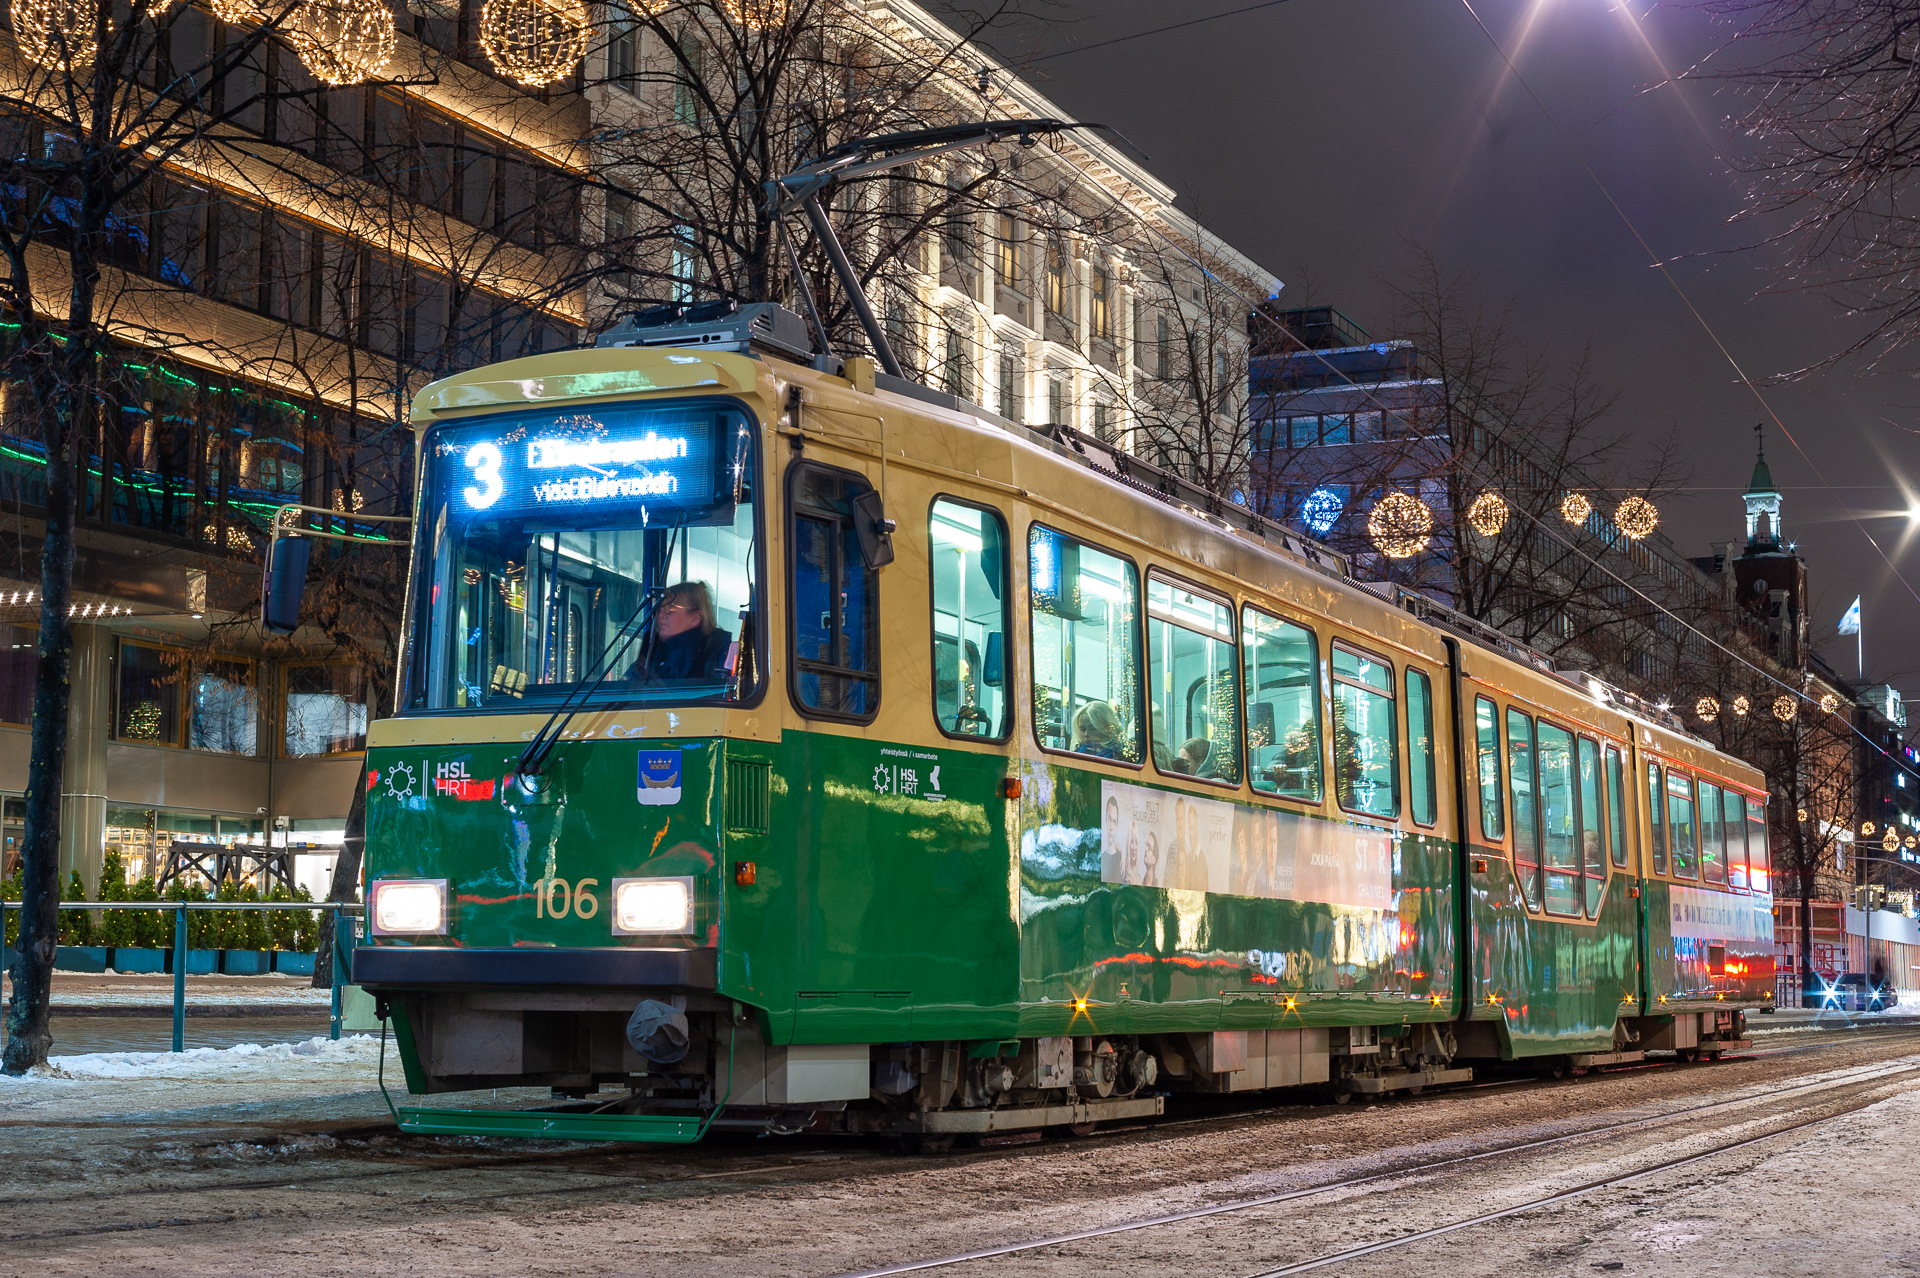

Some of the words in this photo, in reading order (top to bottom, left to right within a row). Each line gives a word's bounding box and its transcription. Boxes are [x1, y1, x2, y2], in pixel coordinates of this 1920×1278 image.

[465, 442, 504, 510] 3
[436, 762, 471, 779] HSL
[900, 768, 919, 782] HSL
[436, 778, 470, 797] HRT
[900, 782, 919, 795] HRT
[1310, 852, 1325, 867] JOKA
[533, 877, 599, 920] 106
